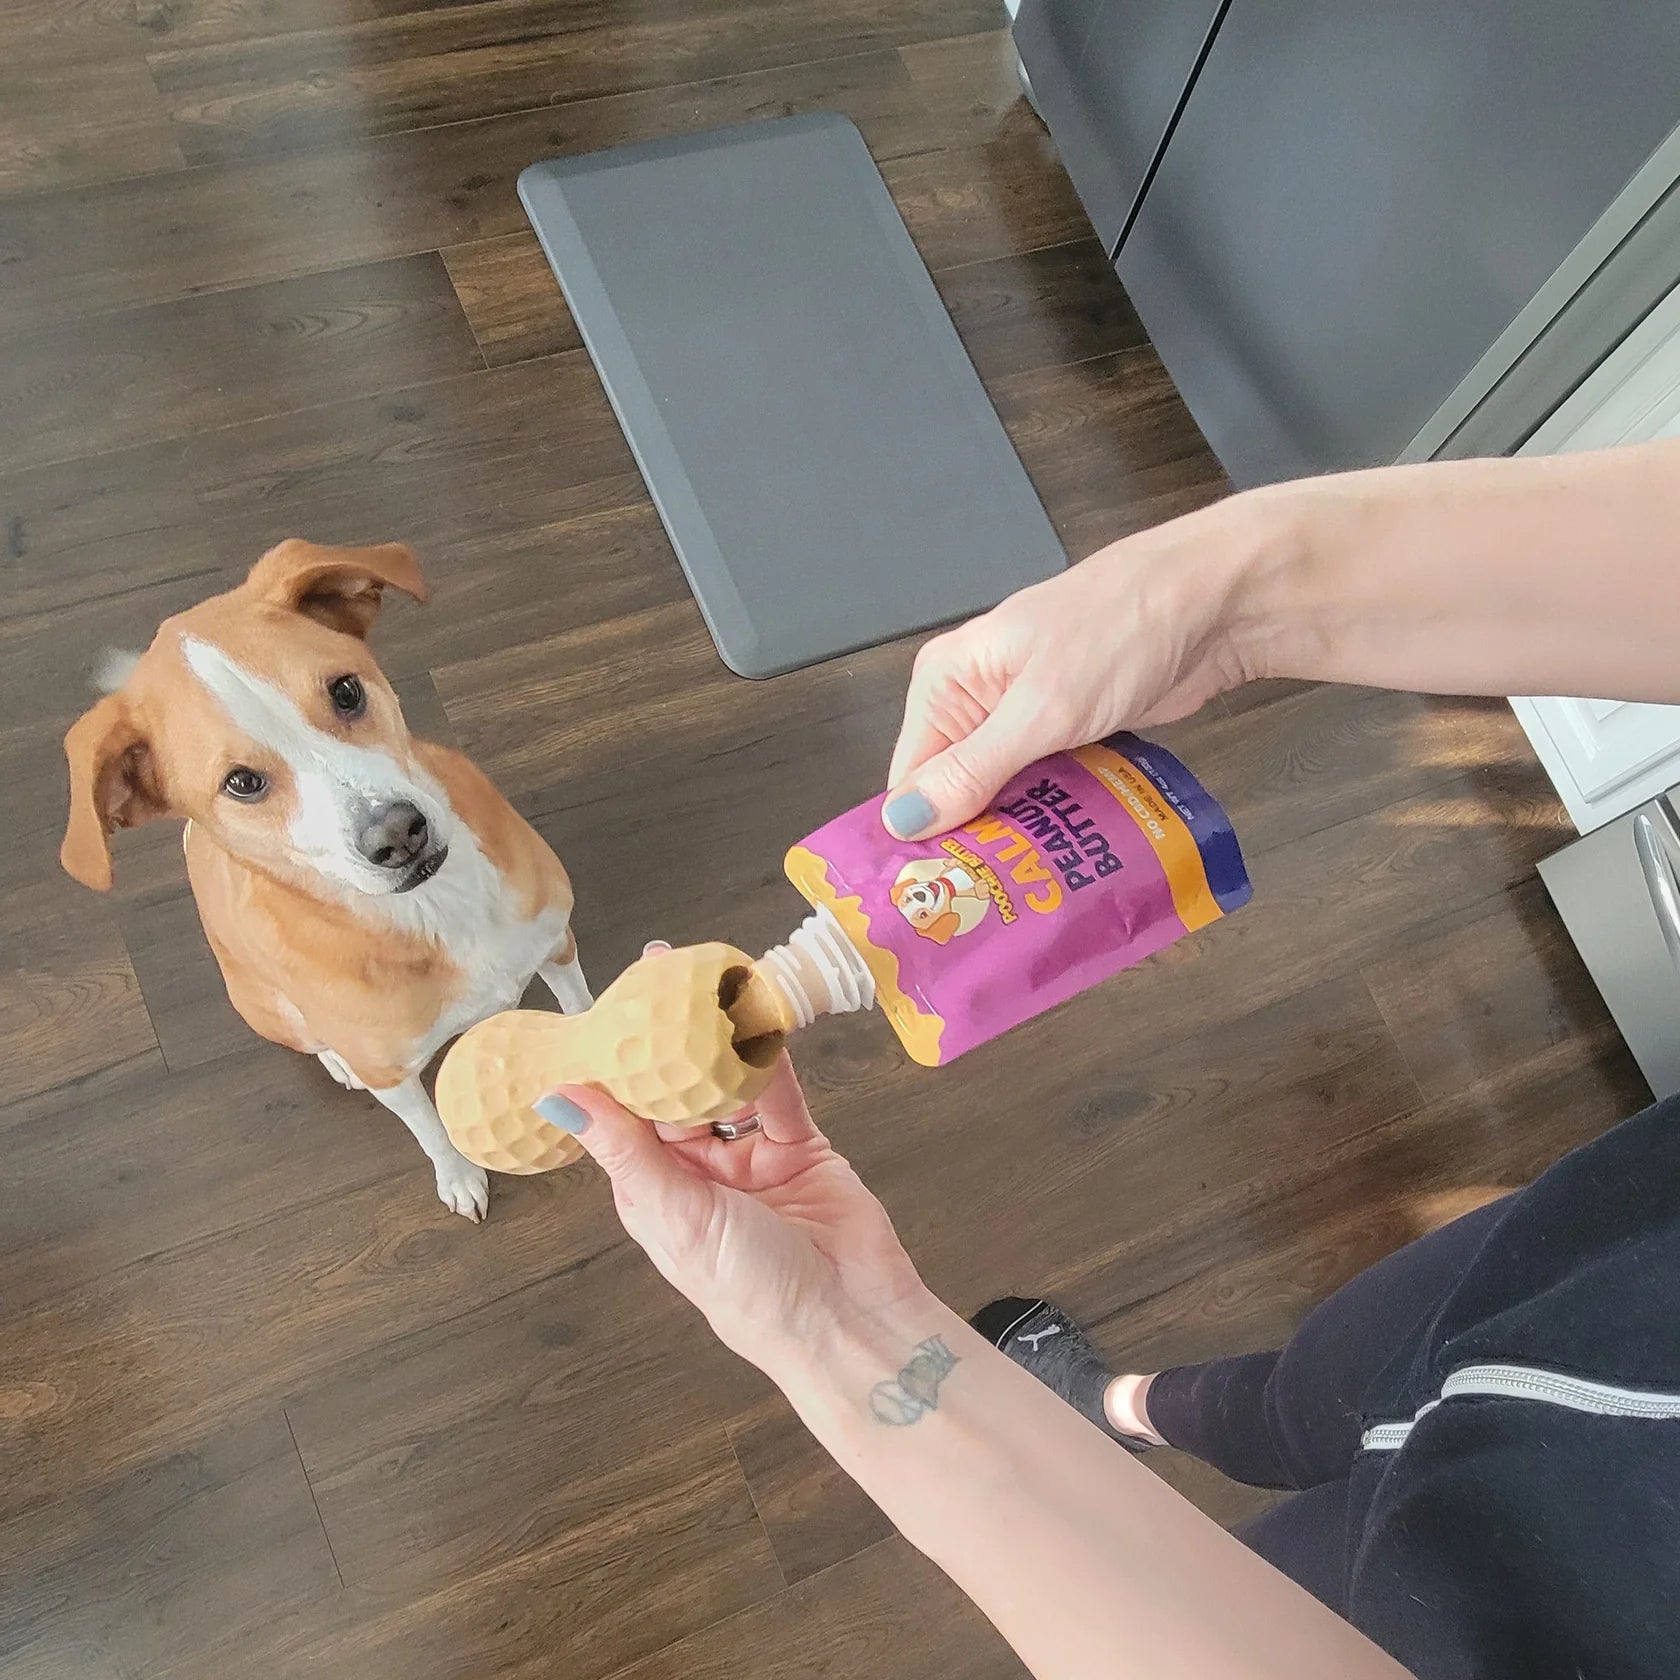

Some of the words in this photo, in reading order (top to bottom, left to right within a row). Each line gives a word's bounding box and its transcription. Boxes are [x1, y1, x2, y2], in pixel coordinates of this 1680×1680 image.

[1118, 767, 1137, 785] USA
[1134, 784, 1146, 796] IN
[1143, 795, 1168, 821] MADE
[1177, 804, 1194, 820] NET
[1026, 779, 1124, 878] BUTTER
[1147, 820, 1166, 840] NO
[940, 838, 984, 868] BUTTER
[998, 799, 1096, 892] PEANUT
[962, 815, 1062, 914] CALM
